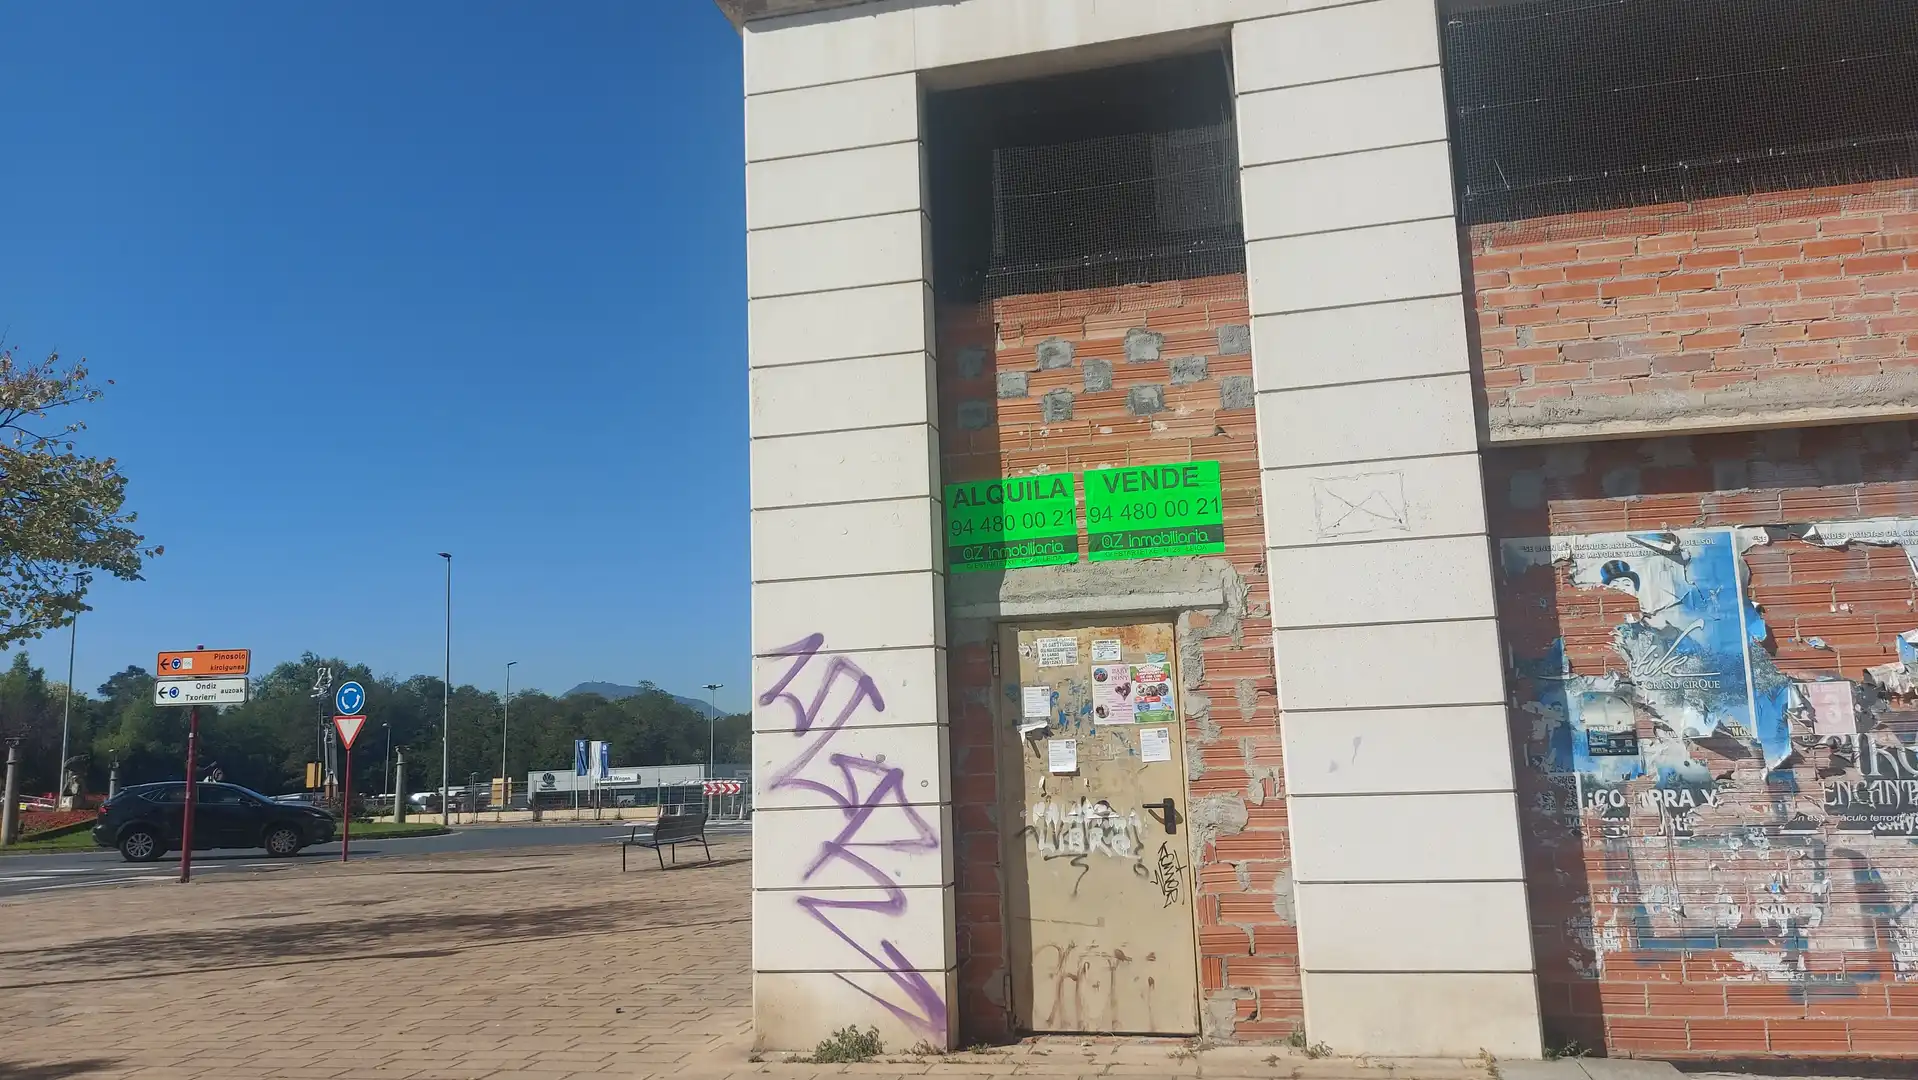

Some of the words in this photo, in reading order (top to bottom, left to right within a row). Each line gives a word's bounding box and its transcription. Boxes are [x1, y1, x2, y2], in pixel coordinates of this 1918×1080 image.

[1102, 466, 1199, 493] VENDE
[953, 478, 1068, 508] ALQUILA
[1090, 505, 1112, 523] 94
[1121, 502, 1157, 520] 480
[1164, 500, 1189, 517] 00
[1196, 496, 1219, 515] 21
[952, 518, 974, 536] 94
[980, 514, 1015, 532] 480
[1022, 512, 1046, 529] 00
[1053, 509, 1074, 526] 21
[1129, 529, 1208, 548] inmobiliaria
[1573, 542, 1608, 551] GRANDES
[1701, 537, 1716, 545] SOL
[989, 540, 1064, 559] inmobiliaria
[195, 682, 217, 690] Ondiz
[1645, 681, 1681, 691] GRAND
[1682, 679, 1721, 690] CIRQUE
[185, 693, 217, 701] Txorierri
